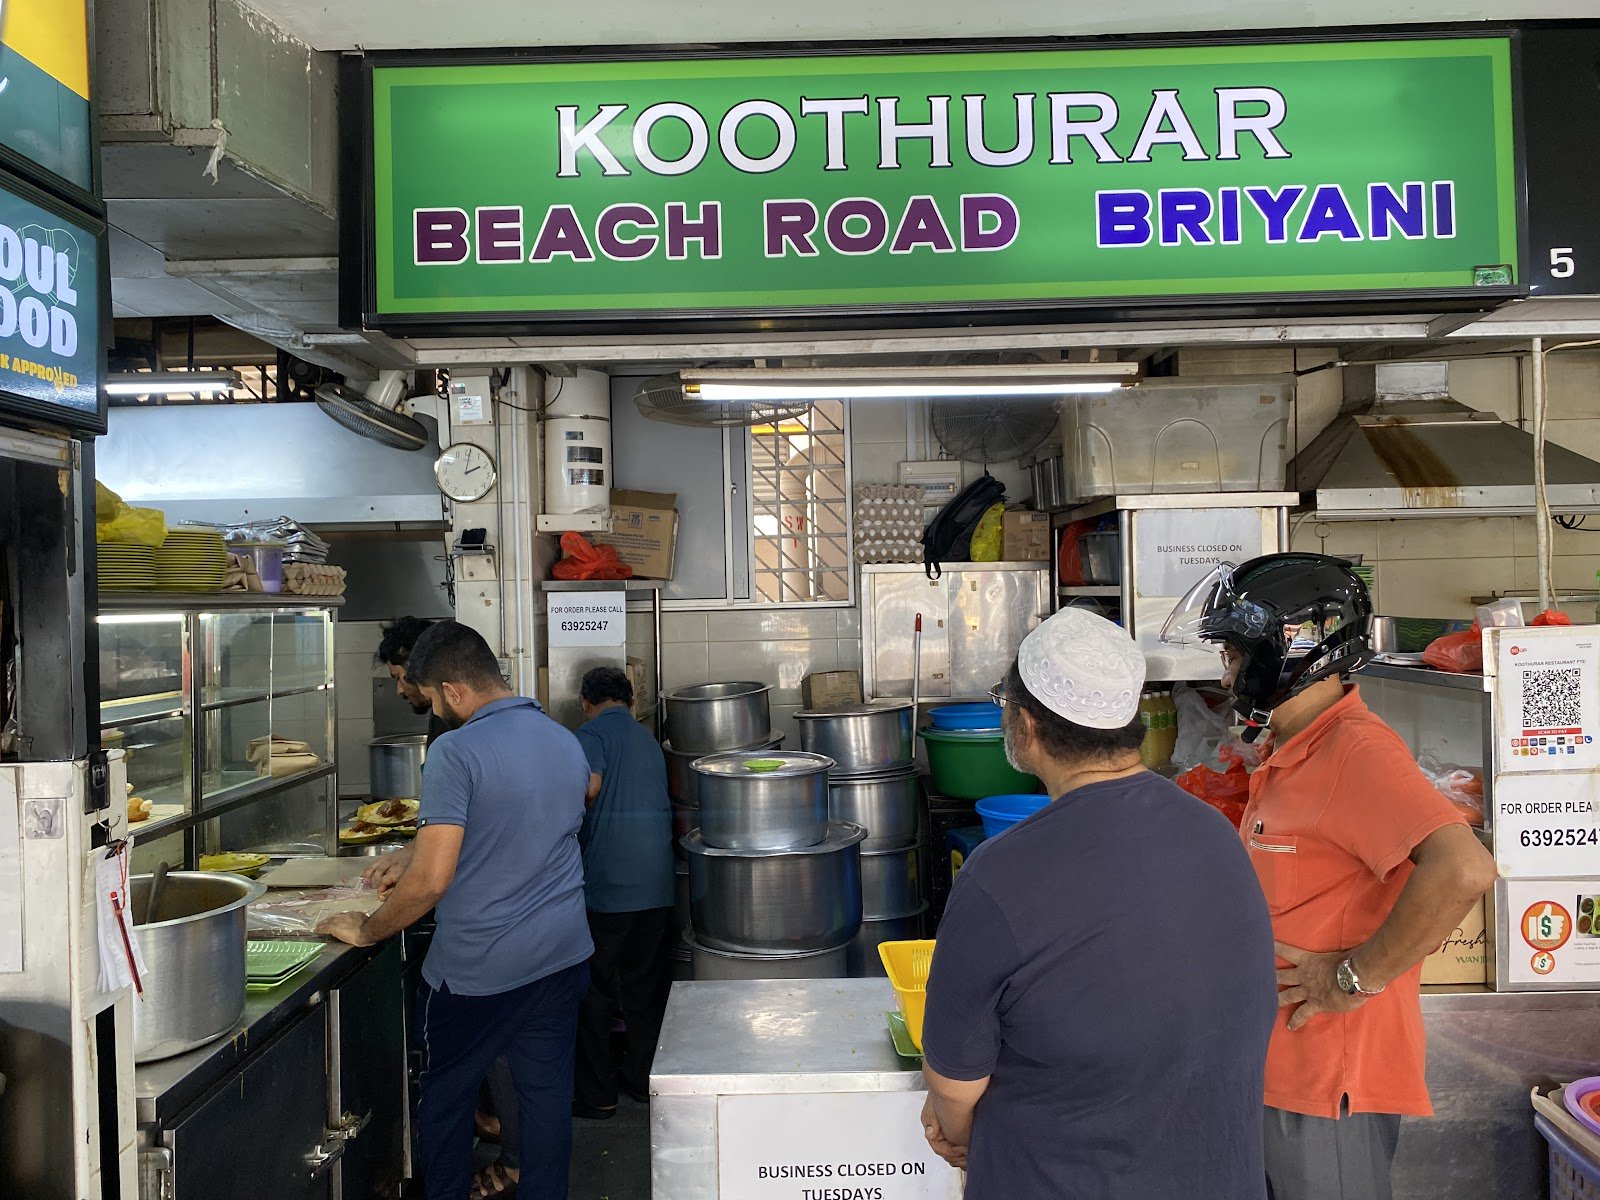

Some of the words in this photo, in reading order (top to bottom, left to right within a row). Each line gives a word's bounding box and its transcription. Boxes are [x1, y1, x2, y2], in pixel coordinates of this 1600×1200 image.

[556, 86, 1292, 177] KOOTHURAR
[413, 201, 722, 266] BEACH
[763, 193, 1021, 258] ROAD
[1095, 180, 1456, 248] BRIYANI
[1550, 247, 1575, 278] 5
[1157, 545, 1195, 553] BUSINESS
[1229, 544, 1242, 552] ON
[1179, 557, 1220, 565] TUESDAYS
[550, 606, 563, 614] FOR
[563, 606, 584, 614] ORDER
[561, 620, 608, 631] 63925247
[1500, 803, 1522, 814] FOR
[1525, 802, 1562, 814] ORDER
[1520, 828, 1600, 847] 6392524
[758, 1164, 833, 1179] BUSINESS
[837, 1163, 897, 1177] CLOSED
[901, 1162, 925, 1175] ON
